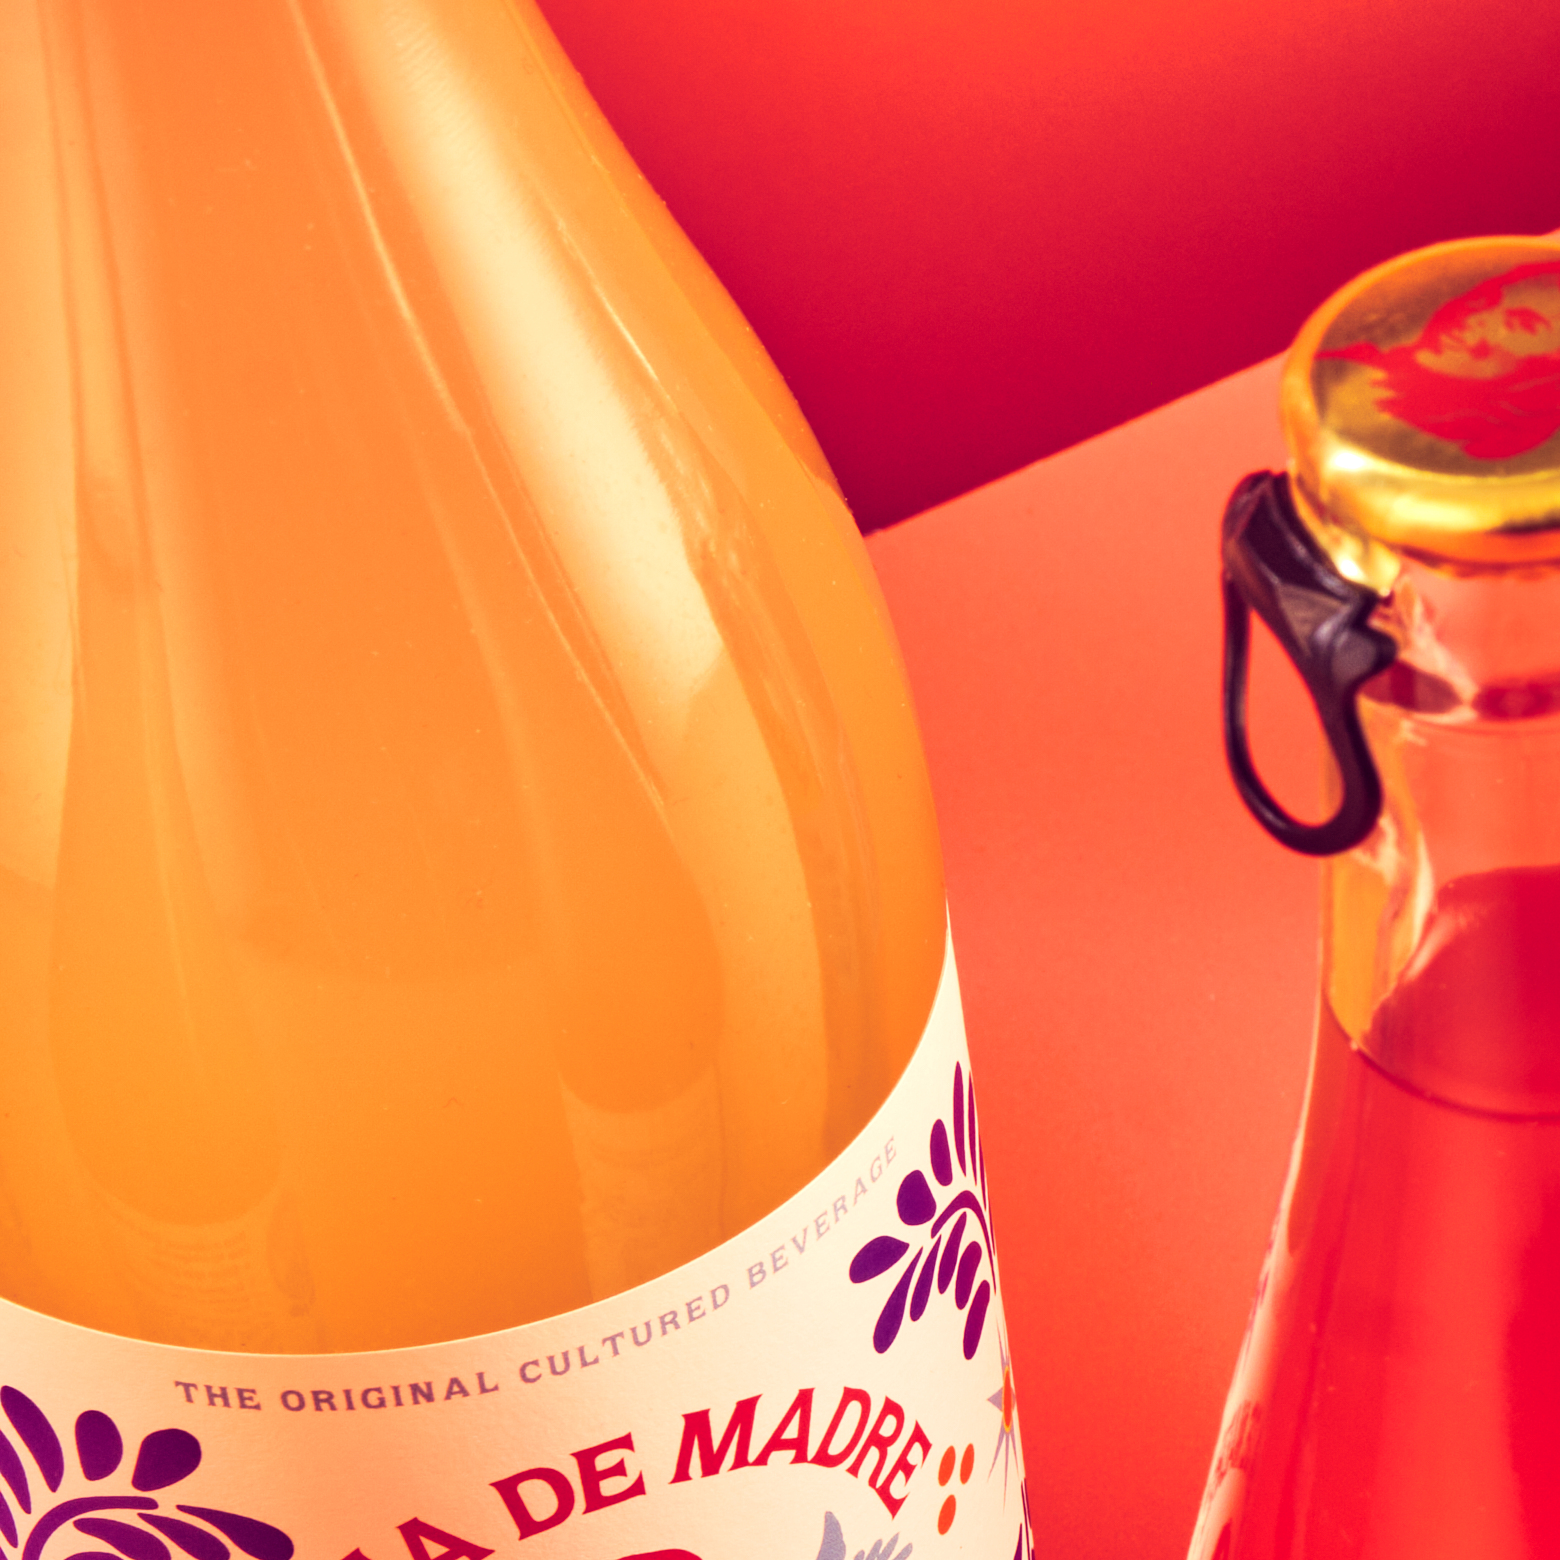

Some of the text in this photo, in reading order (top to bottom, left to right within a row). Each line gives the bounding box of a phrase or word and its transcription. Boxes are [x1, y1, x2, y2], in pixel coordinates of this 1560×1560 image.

[174, 1135, 901, 1414] THE ORIGINAL CULTURED BEVERAGE
[489, 1433, 645, 1542] DE
[667, 1385, 933, 1519] MADRE
